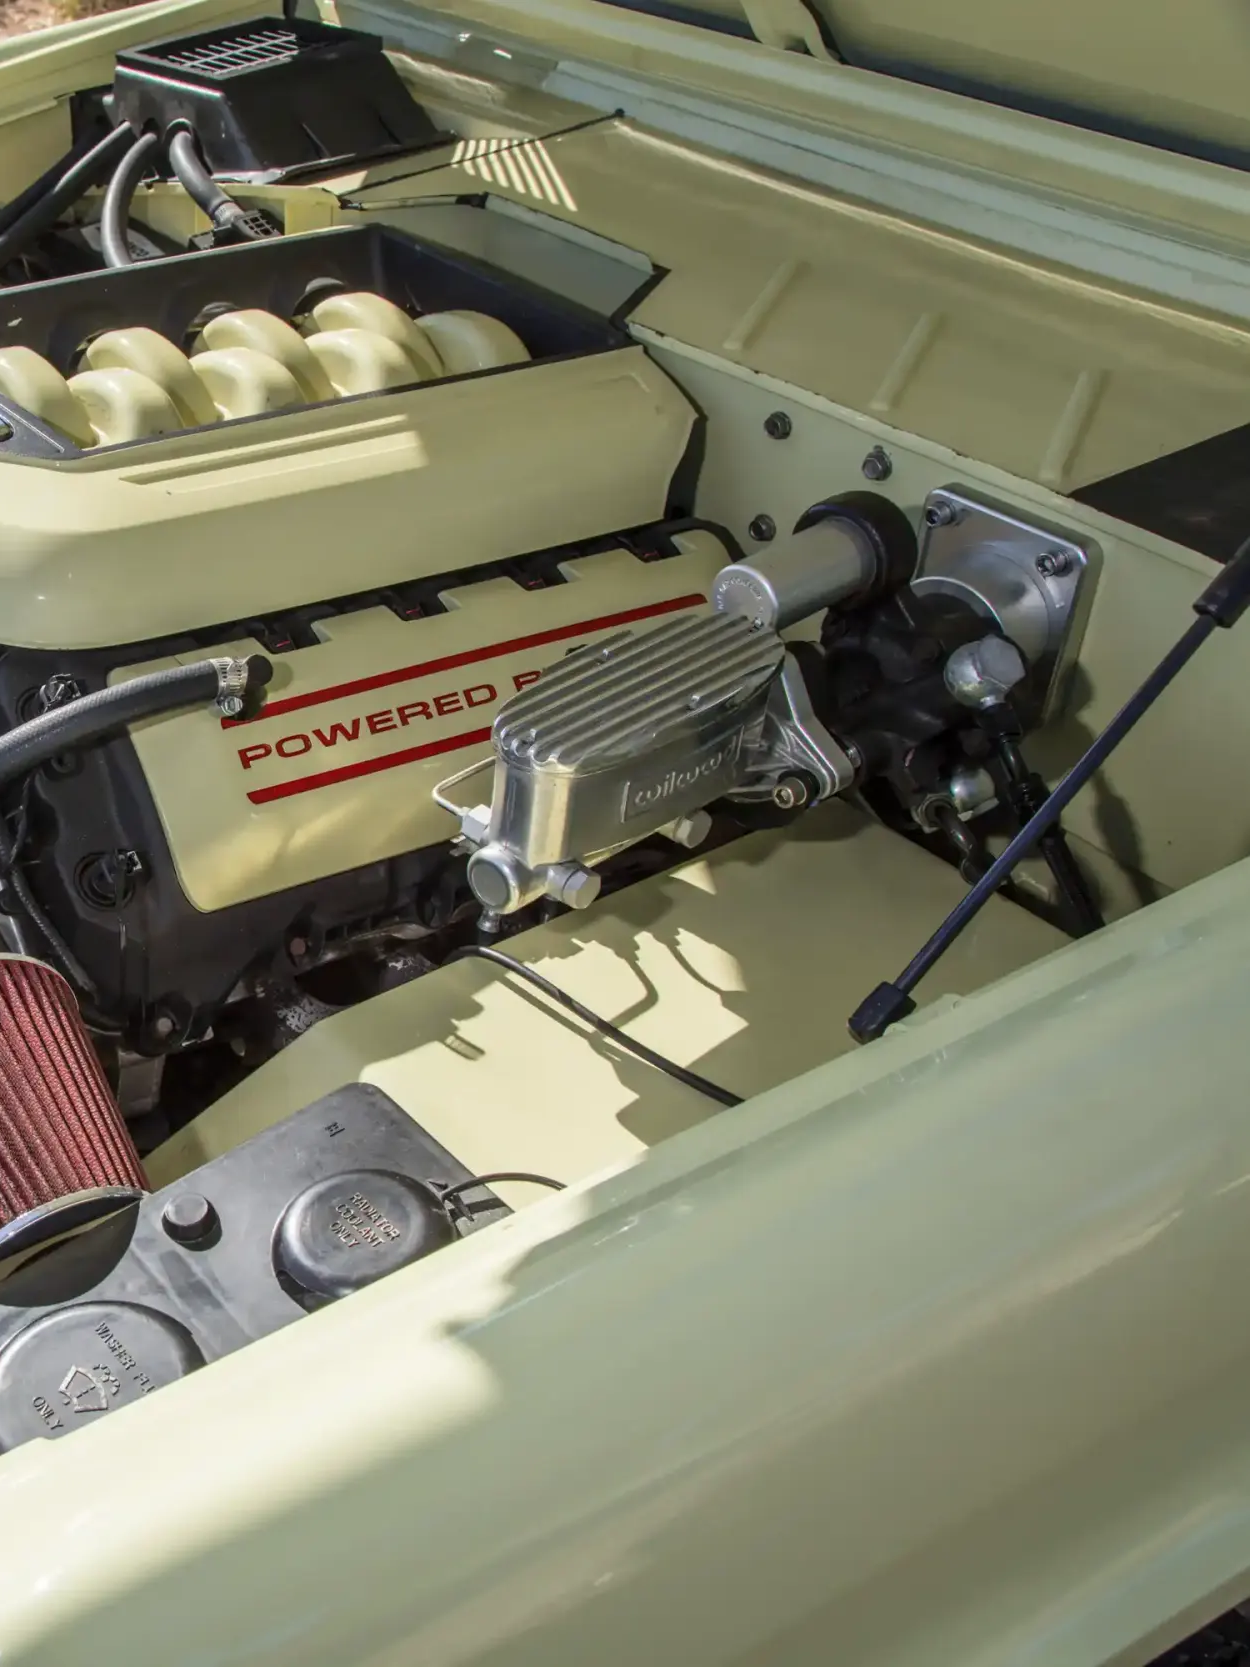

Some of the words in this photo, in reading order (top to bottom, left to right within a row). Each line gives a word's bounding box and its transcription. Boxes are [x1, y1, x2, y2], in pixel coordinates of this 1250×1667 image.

[237, 683, 498, 770] POWERED
[329, 1220, 360, 1248] ONLY
[335, 1203, 386, 1248] COOLANT
[350, 1192, 401, 1241] RADIATOR
[95, 1321, 137, 1371] WASHER
[32, 1396, 64, 1431] ONLY
